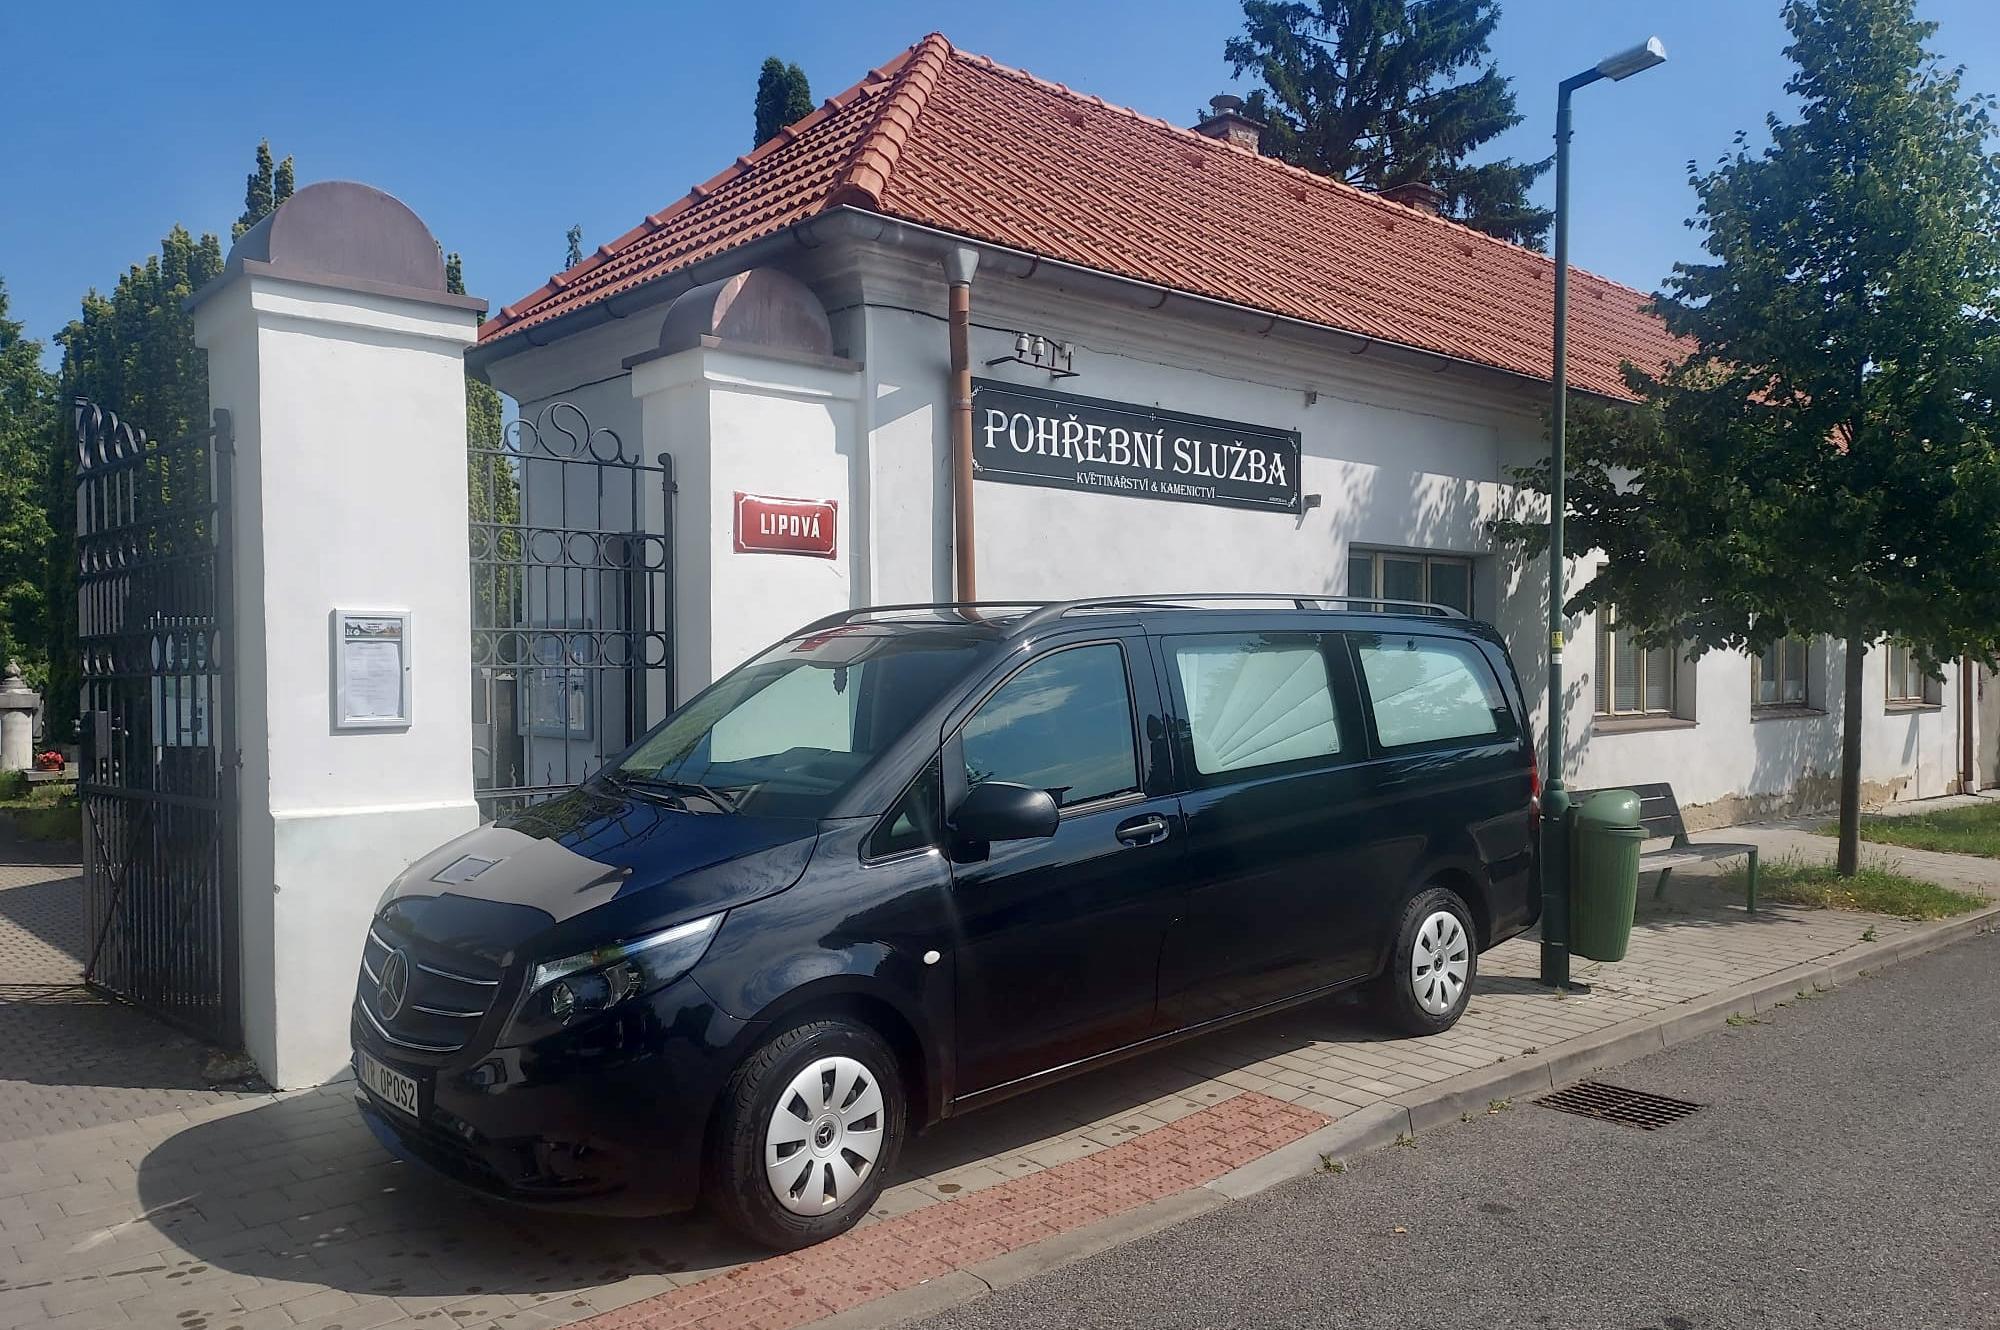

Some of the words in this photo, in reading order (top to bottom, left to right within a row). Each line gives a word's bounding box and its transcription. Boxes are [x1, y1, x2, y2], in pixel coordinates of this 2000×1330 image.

[983, 408, 1164, 470] POHŘEBNÍ
[1173, 437, 1288, 487] SLUŽBA
[1076, 472, 1149, 491] KVĚTINÁŘSTVÍ
[1151, 481, 1159, 492] &
[1160, 482, 1216, 499] KAMENICTVÍ
[760, 513, 822, 538] LIPOVÁ
